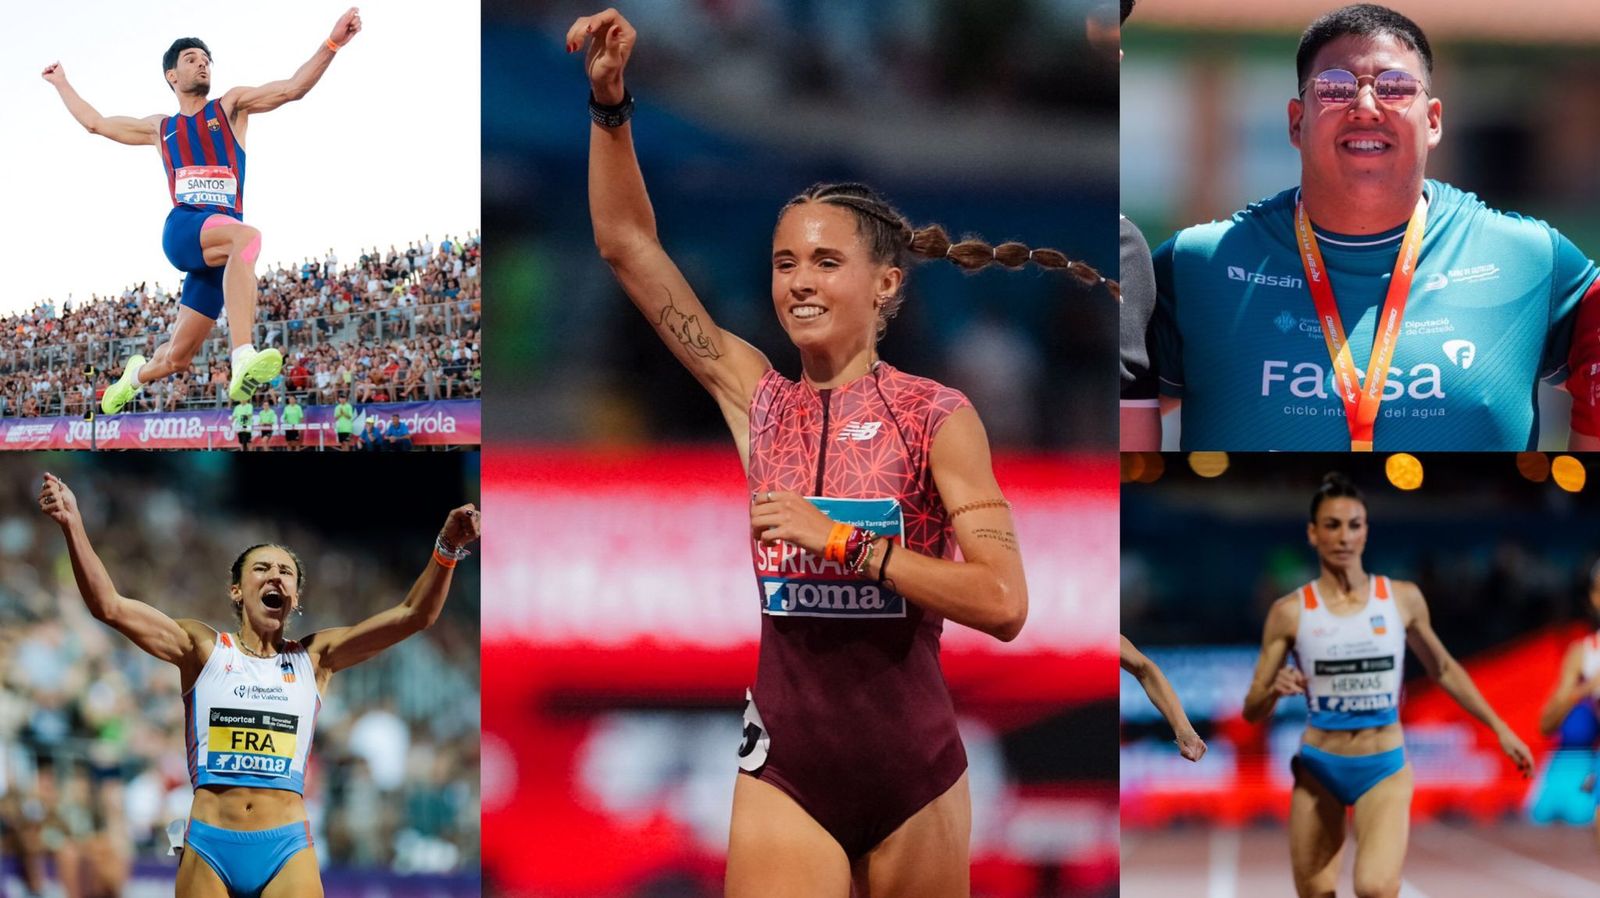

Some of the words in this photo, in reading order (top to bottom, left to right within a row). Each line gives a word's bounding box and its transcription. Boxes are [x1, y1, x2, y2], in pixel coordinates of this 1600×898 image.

[188, 179, 224, 189] SANTOS
[1247, 272, 1302, 289] rasán
[1405, 318, 1450, 328] Diputació
[1284, 405, 1318, 416] ciclo
[1384, 406, 1406, 418] del
[1411, 407, 1446, 420] agua
[371, 411, 456, 434] bdrola
[865, 520, 899, 528] Tarragona
[757, 539, 850, 576] SERRA
[781, 583, 885, 611] Joma
[220, 715, 255, 724] esportcat
[231, 731, 276, 752] FRA
[231, 755, 285, 772] Joma
